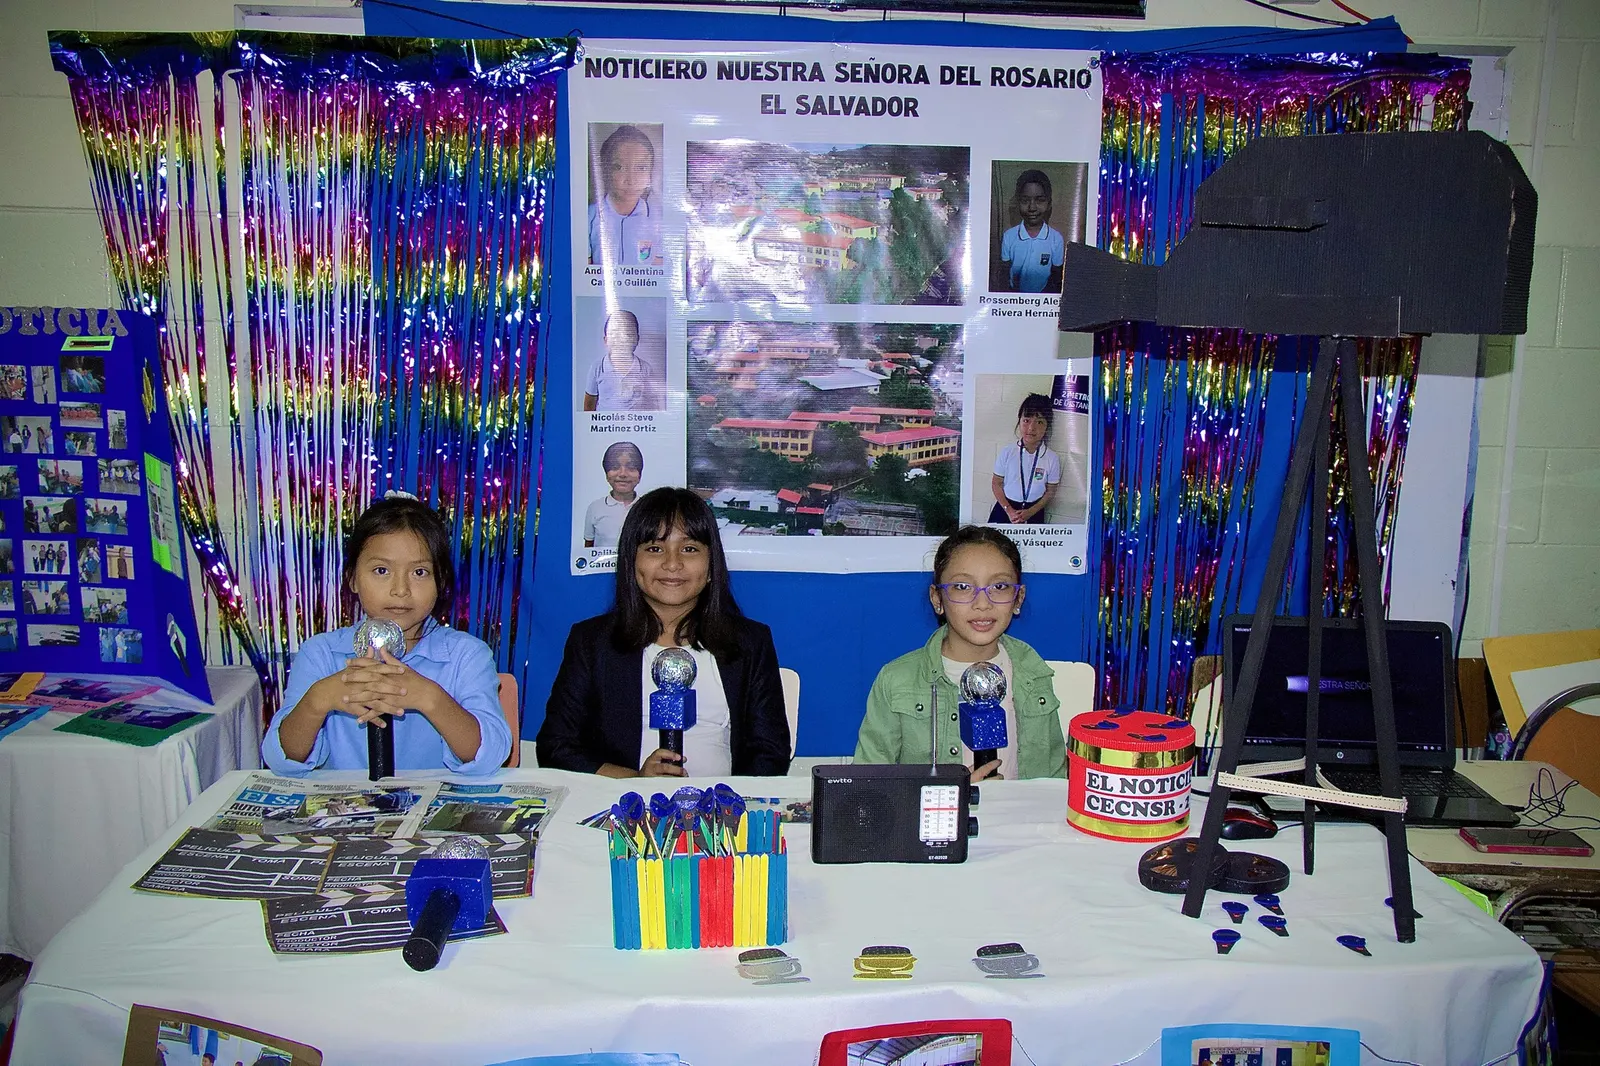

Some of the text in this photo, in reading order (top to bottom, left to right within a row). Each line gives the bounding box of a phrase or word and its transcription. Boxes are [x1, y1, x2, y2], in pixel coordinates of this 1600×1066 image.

[584, 57, 1093, 89] NOTICIERO NUESTRA SEÑORA DEL ROSARIO
[760, 94, 920, 118] EL SALVADOR
[620, 266, 664, 276] Valentina
[624, 278, 658, 287] Guillén
[979, 296, 1041, 307] Rossemberg
[991, 308, 1023, 317] Rivera
[591, 413, 654, 421] Nicolás Steve
[633, 424, 657, 433] Ortiz
[1039, 527, 1073, 535] Valeria
[1022, 538, 1064, 548] Vásquez
[1086, 771, 1114, 793] EL
[1086, 794, 1176, 818] CECNSR
[180, 844, 241, 853] PELICULA
[178, 851, 230, 860] ESCENA
[151, 872, 206, 880] PRODUCTOR
[148, 878, 201, 887] DIRECTOR
[275, 907, 343, 918] PELICULA
[280, 907, 402, 924] ESCENA TOMA
[275, 930, 315, 938] FECHA
[276, 935, 337, 944] PRODUCTOR
